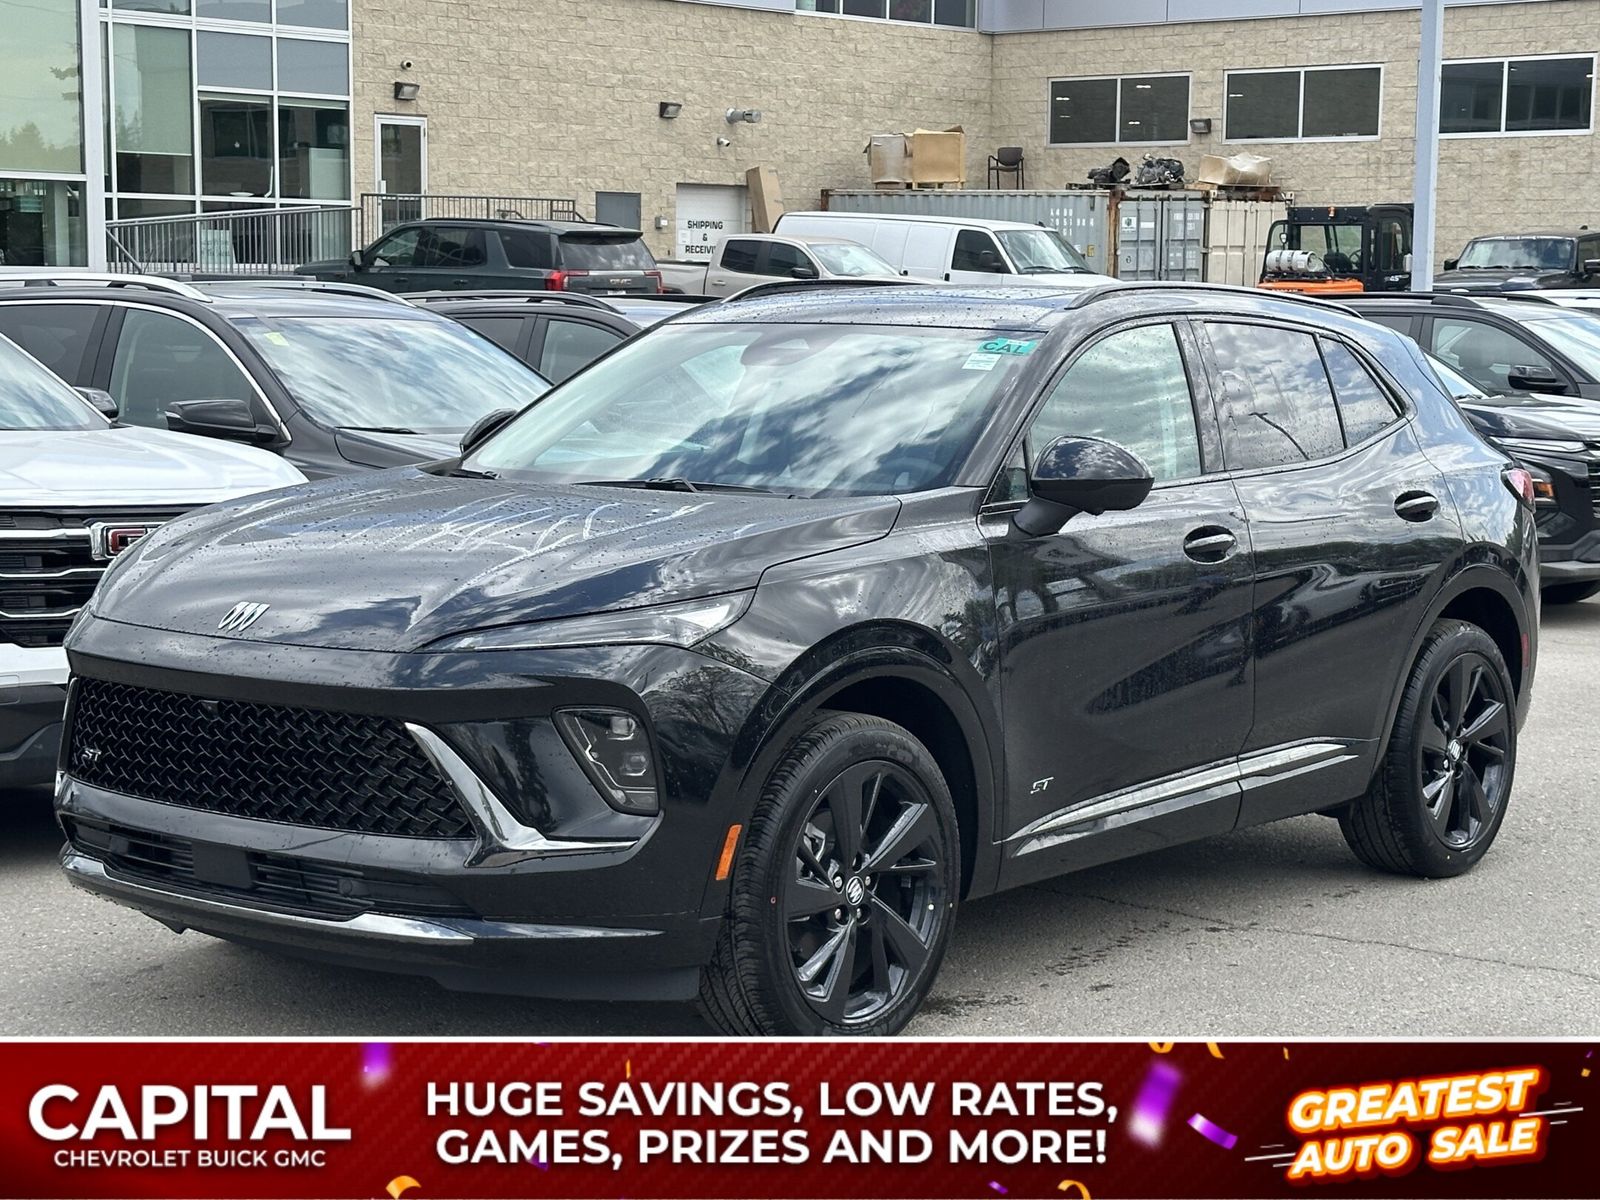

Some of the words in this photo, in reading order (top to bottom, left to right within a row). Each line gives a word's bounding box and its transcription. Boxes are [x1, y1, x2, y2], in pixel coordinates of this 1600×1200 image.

[687, 220, 723, 229] SHIPPING
[702, 233, 708, 241] &
[685, 245, 716, 254] RECEIVI
[982, 342, 1025, 355] CAL
[82, 747, 102, 761] ST
[1030, 776, 1055, 794] ST
